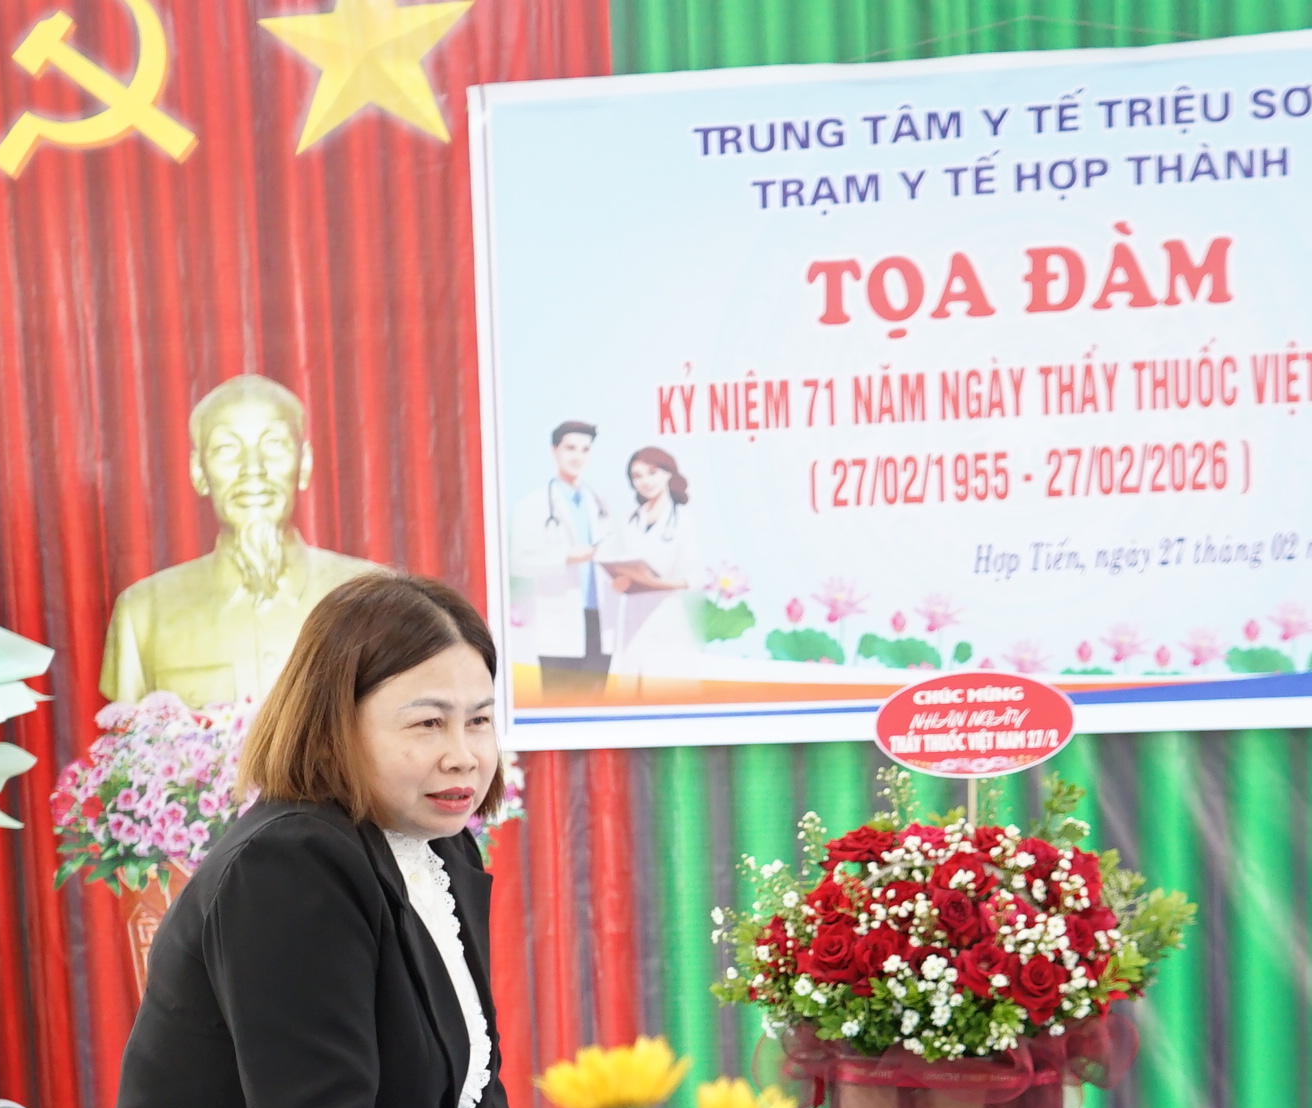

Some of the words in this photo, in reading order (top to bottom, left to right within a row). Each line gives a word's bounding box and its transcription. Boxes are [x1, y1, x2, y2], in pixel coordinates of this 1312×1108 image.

[692, 117, 845, 157] TRUNG
[861, 104, 962, 146] TÂM
[980, 107, 1010, 138] Y
[1025, 87, 1085, 135] TẾ
[1096, 85, 1232, 135] TRIỆU
[751, 173, 881, 217] TRẠM
[899, 169, 927, 201] Y
[943, 149, 1000, 198] TẾ
[1014, 157, 1109, 201] HỢP
[1125, 142, 1289, 186] THÀNH
[806, 251, 998, 340] TỌA
[1022, 220, 1235, 315] ĐÀM
[707, 369, 791, 443] NIỆM
[801, 377, 837, 428] 71
[851, 363, 928, 425] NĂM
[939, 356, 1026, 421] NGÀY
[1130, 337, 1239, 411] THUỐC
[831, 450, 1011, 508] 27/02/1955
[1045, 439, 1230, 499] 27/02/2026
[972, 543, 1021, 581] Hợp
[1029, 537, 1086, 574] Tiến,
[1094, 539, 1152, 575] ngày
[1158, 536, 1187, 566] 27
[1193, 534, 1265, 569] tháng
[1271, 531, 1300, 560] 02
[912, 686, 965, 706] CHÚC
[966, 684, 1025, 704] MỪNG
[967, 728, 995, 754] VIỆT
[995, 730, 1027, 750] NAM
